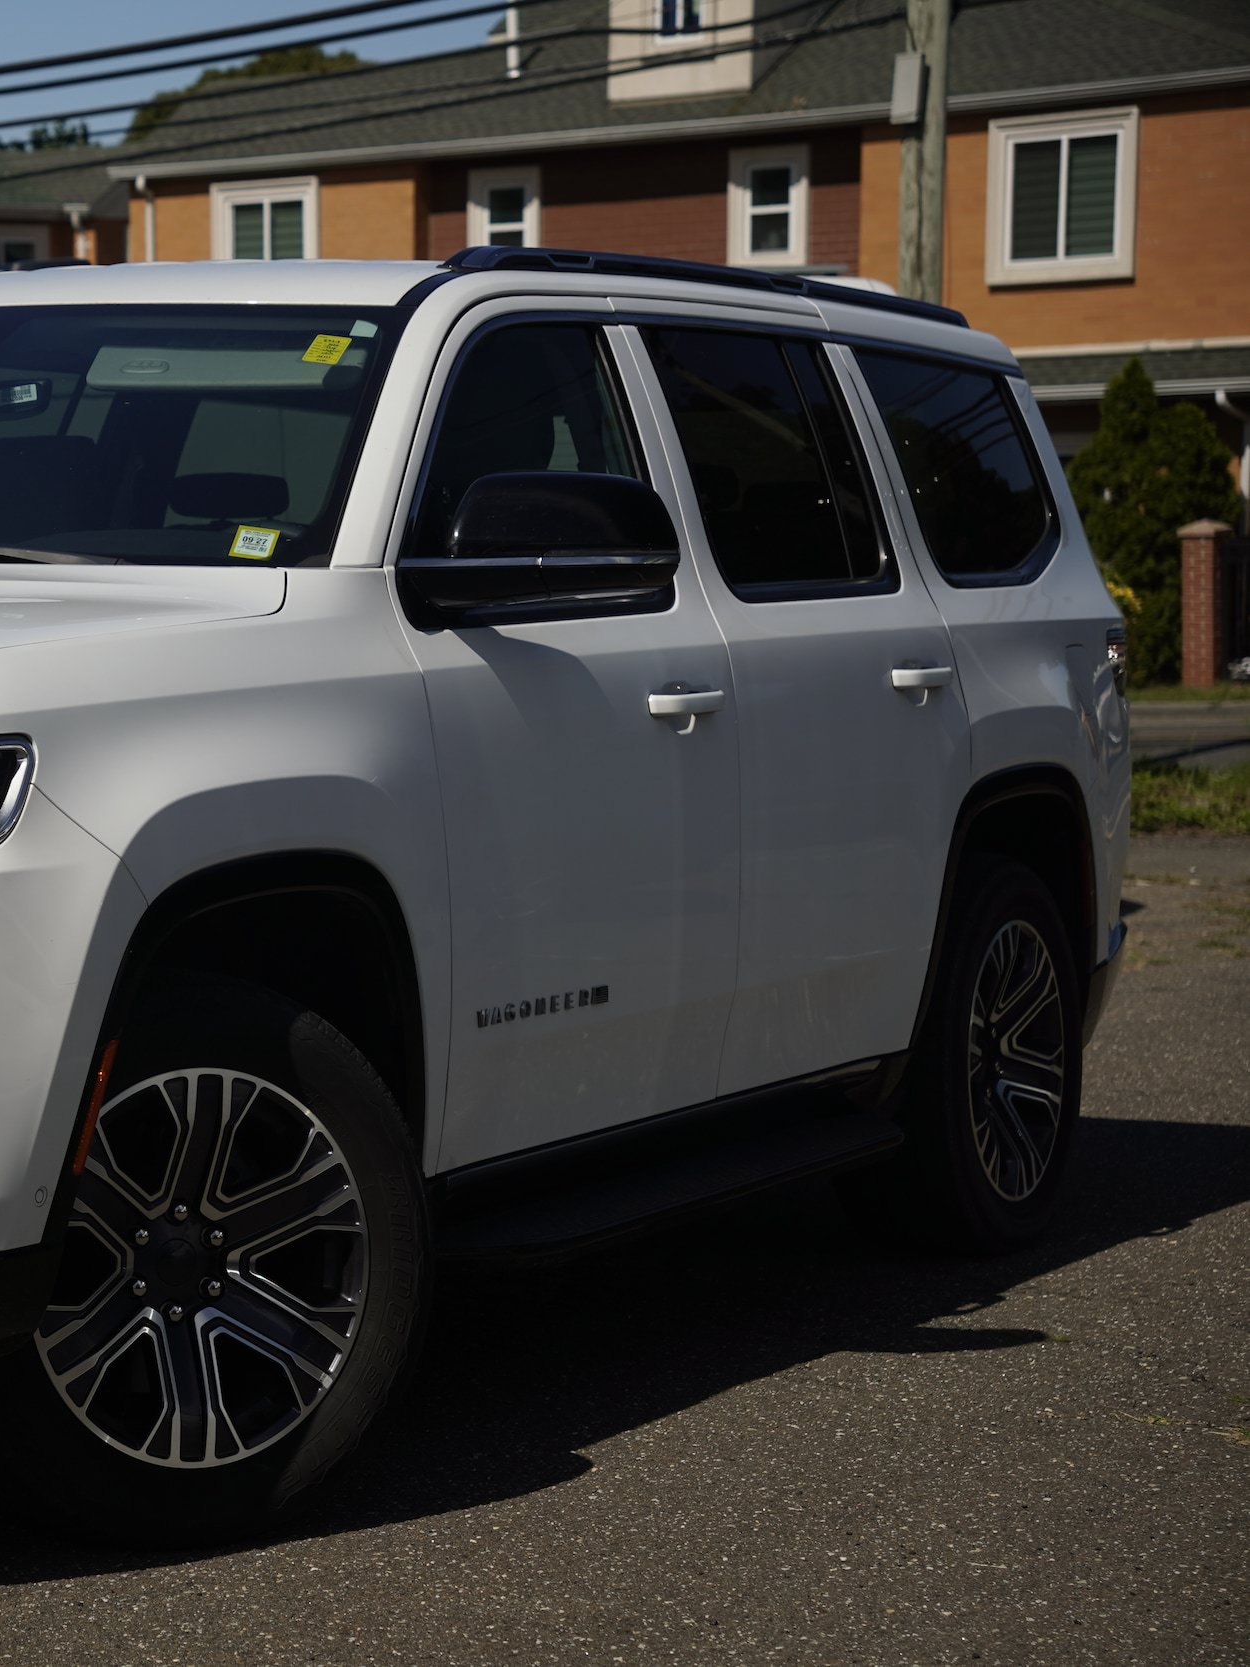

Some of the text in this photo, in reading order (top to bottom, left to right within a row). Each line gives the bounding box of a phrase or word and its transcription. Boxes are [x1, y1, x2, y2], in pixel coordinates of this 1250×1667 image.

[242, 535, 268, 545] 09 27
[476, 989, 590, 1028] WAGONEER
